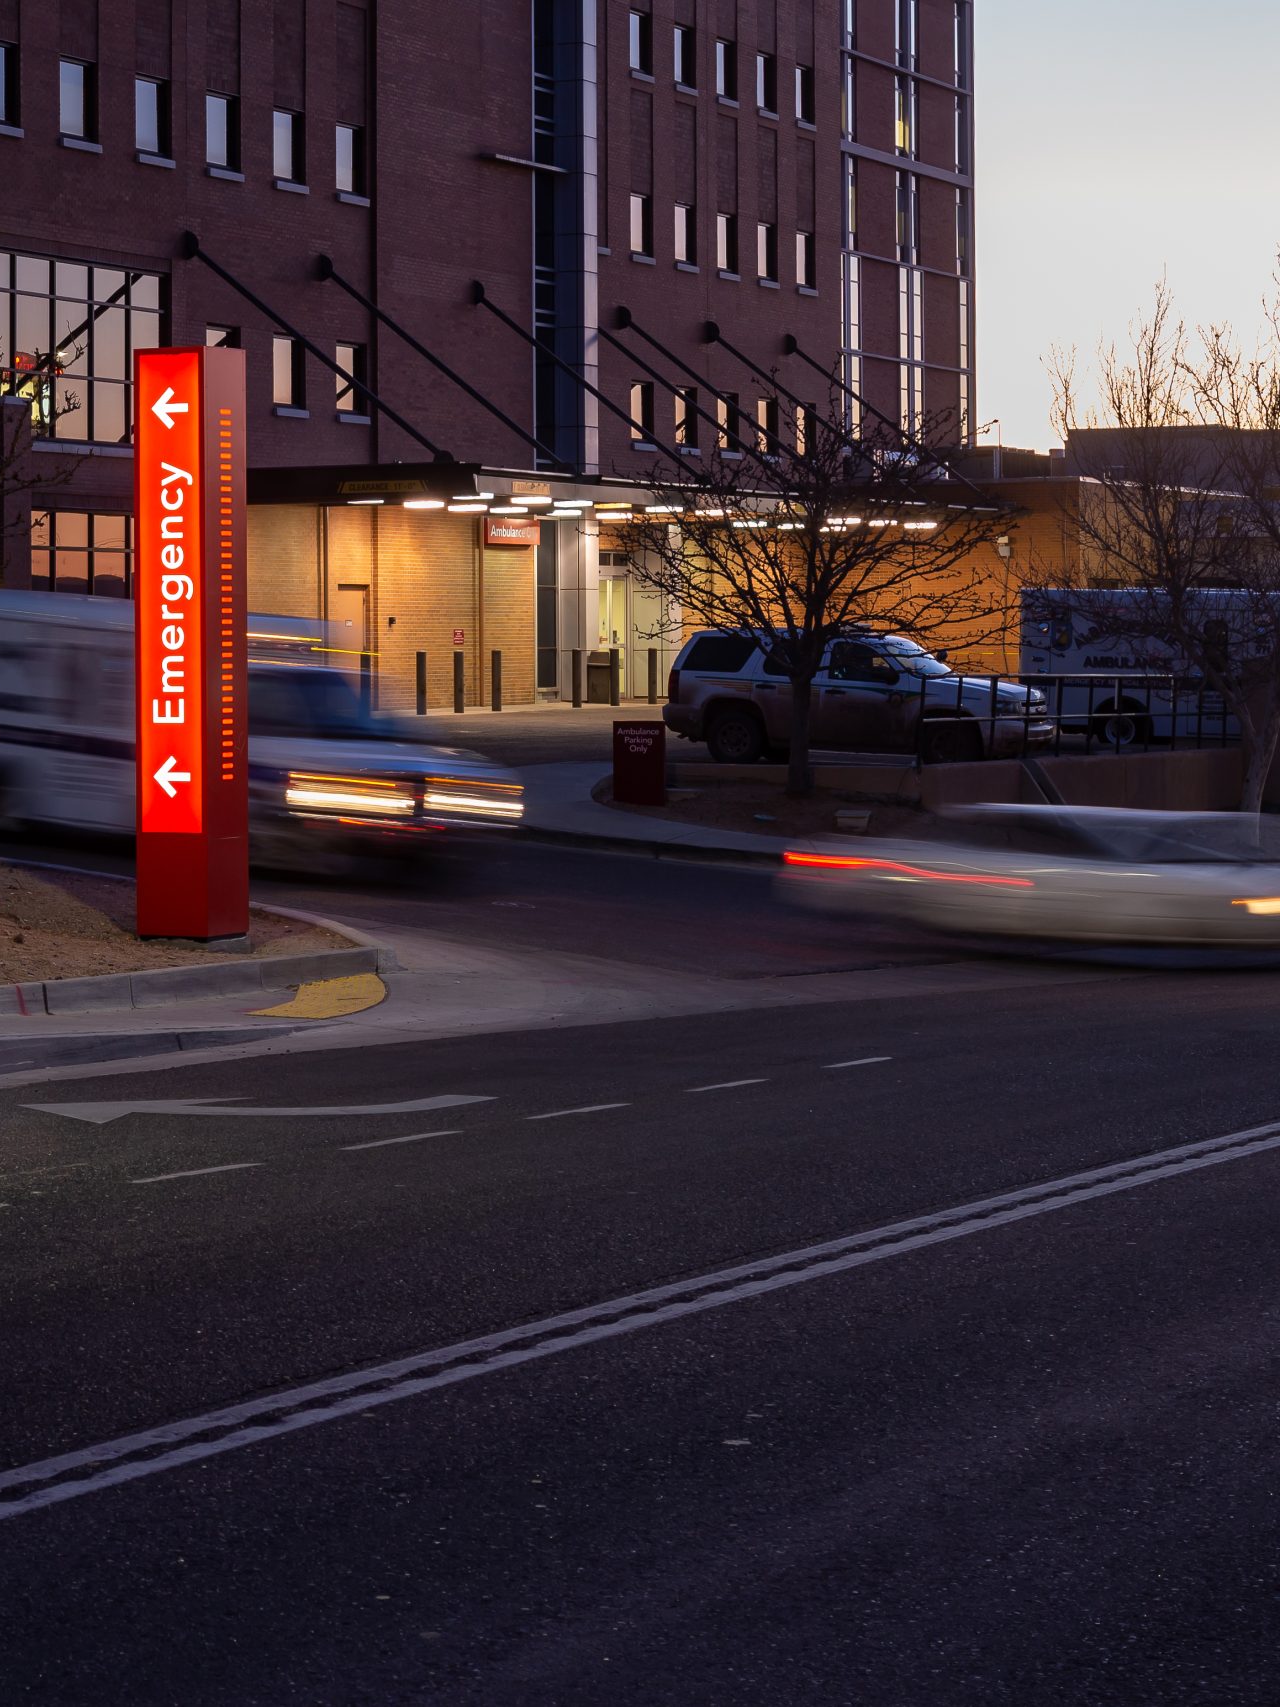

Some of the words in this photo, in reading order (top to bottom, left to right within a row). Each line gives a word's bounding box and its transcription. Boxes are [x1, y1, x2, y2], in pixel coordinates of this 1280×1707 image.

[152, 461, 194, 725] Emergency
[1083, 655, 1173, 669] AMBULANCE
[624, 736, 653, 746] Parking
[629, 745, 648, 754] Only
